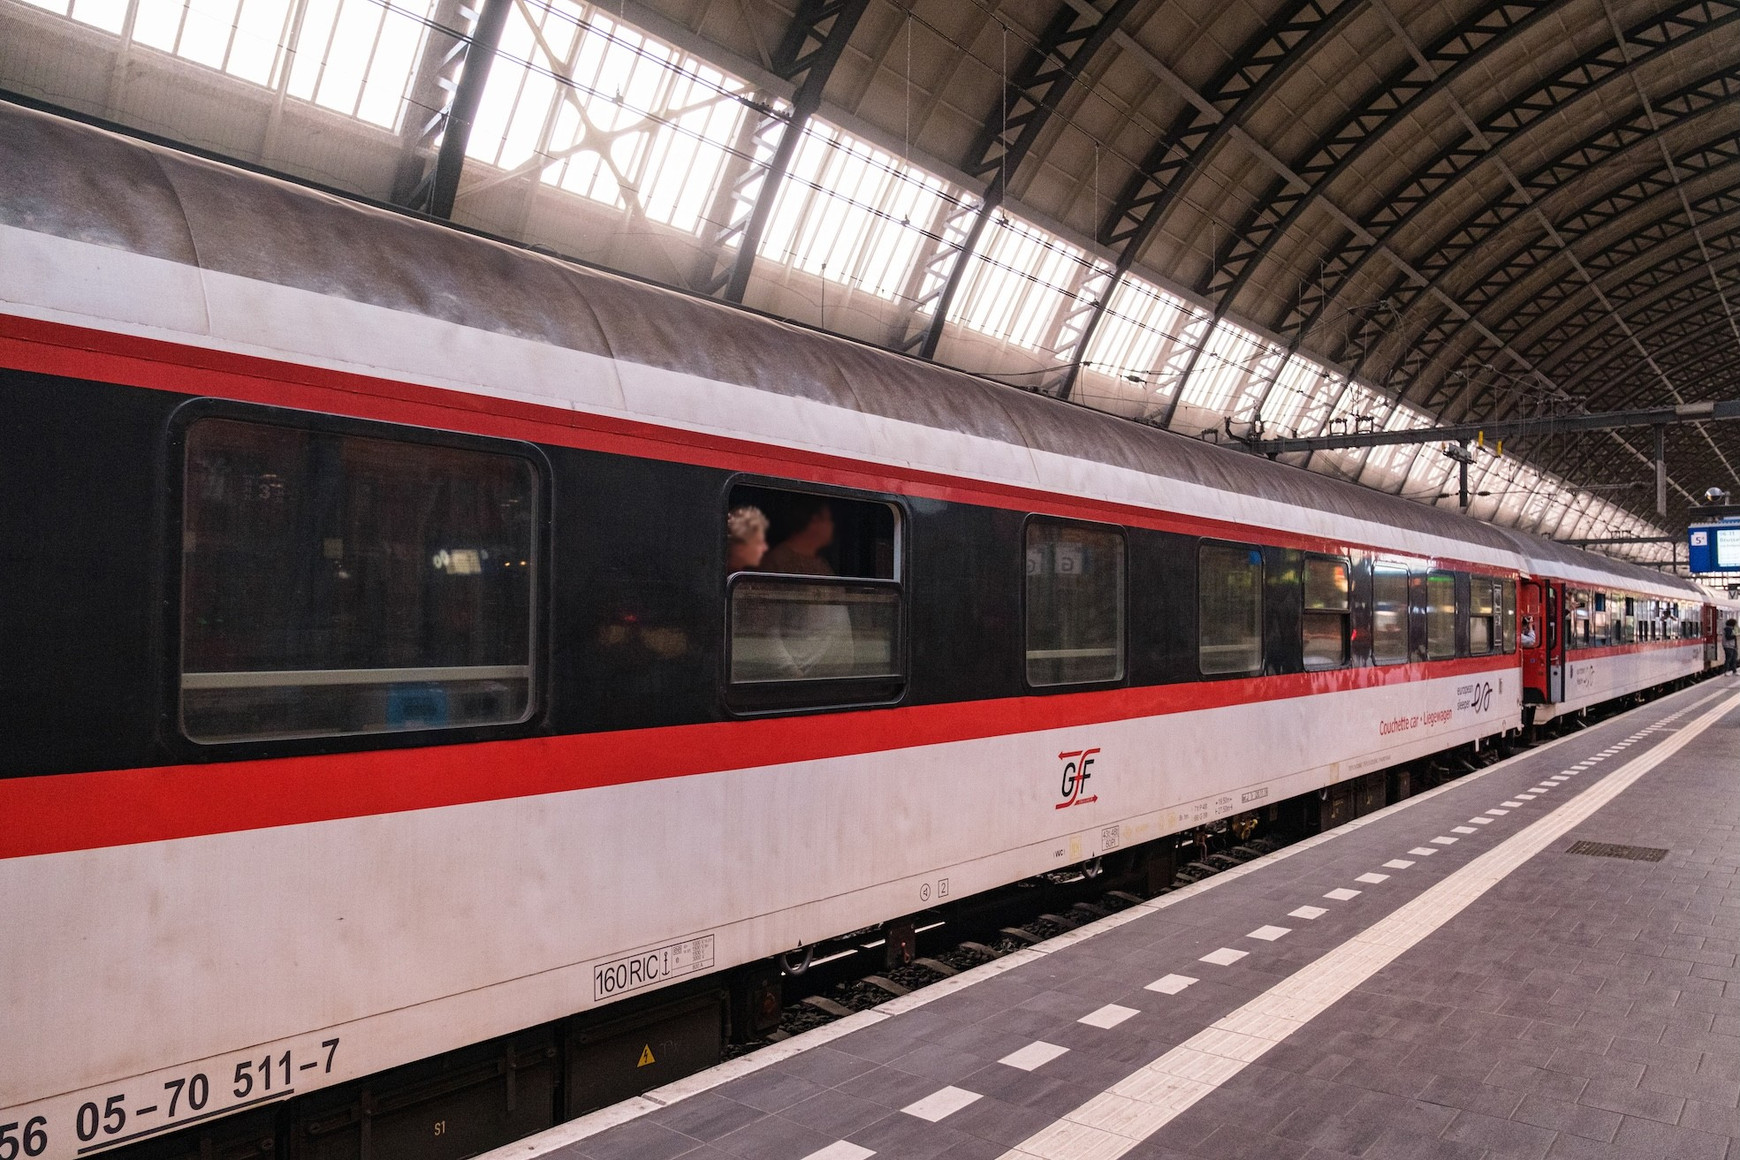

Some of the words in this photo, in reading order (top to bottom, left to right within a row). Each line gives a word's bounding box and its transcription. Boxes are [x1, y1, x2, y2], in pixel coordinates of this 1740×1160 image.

[1380, 717, 1409, 735] Couchette
[1410, 716, 1419, 728] car
[1423, 709, 1453, 727] Liegewagen
[941, 882, 947, 894] 2
[596, 963, 627, 994] 160
[629, 954, 658, 985] RIC
[434, 1120, 446, 1136] S1
